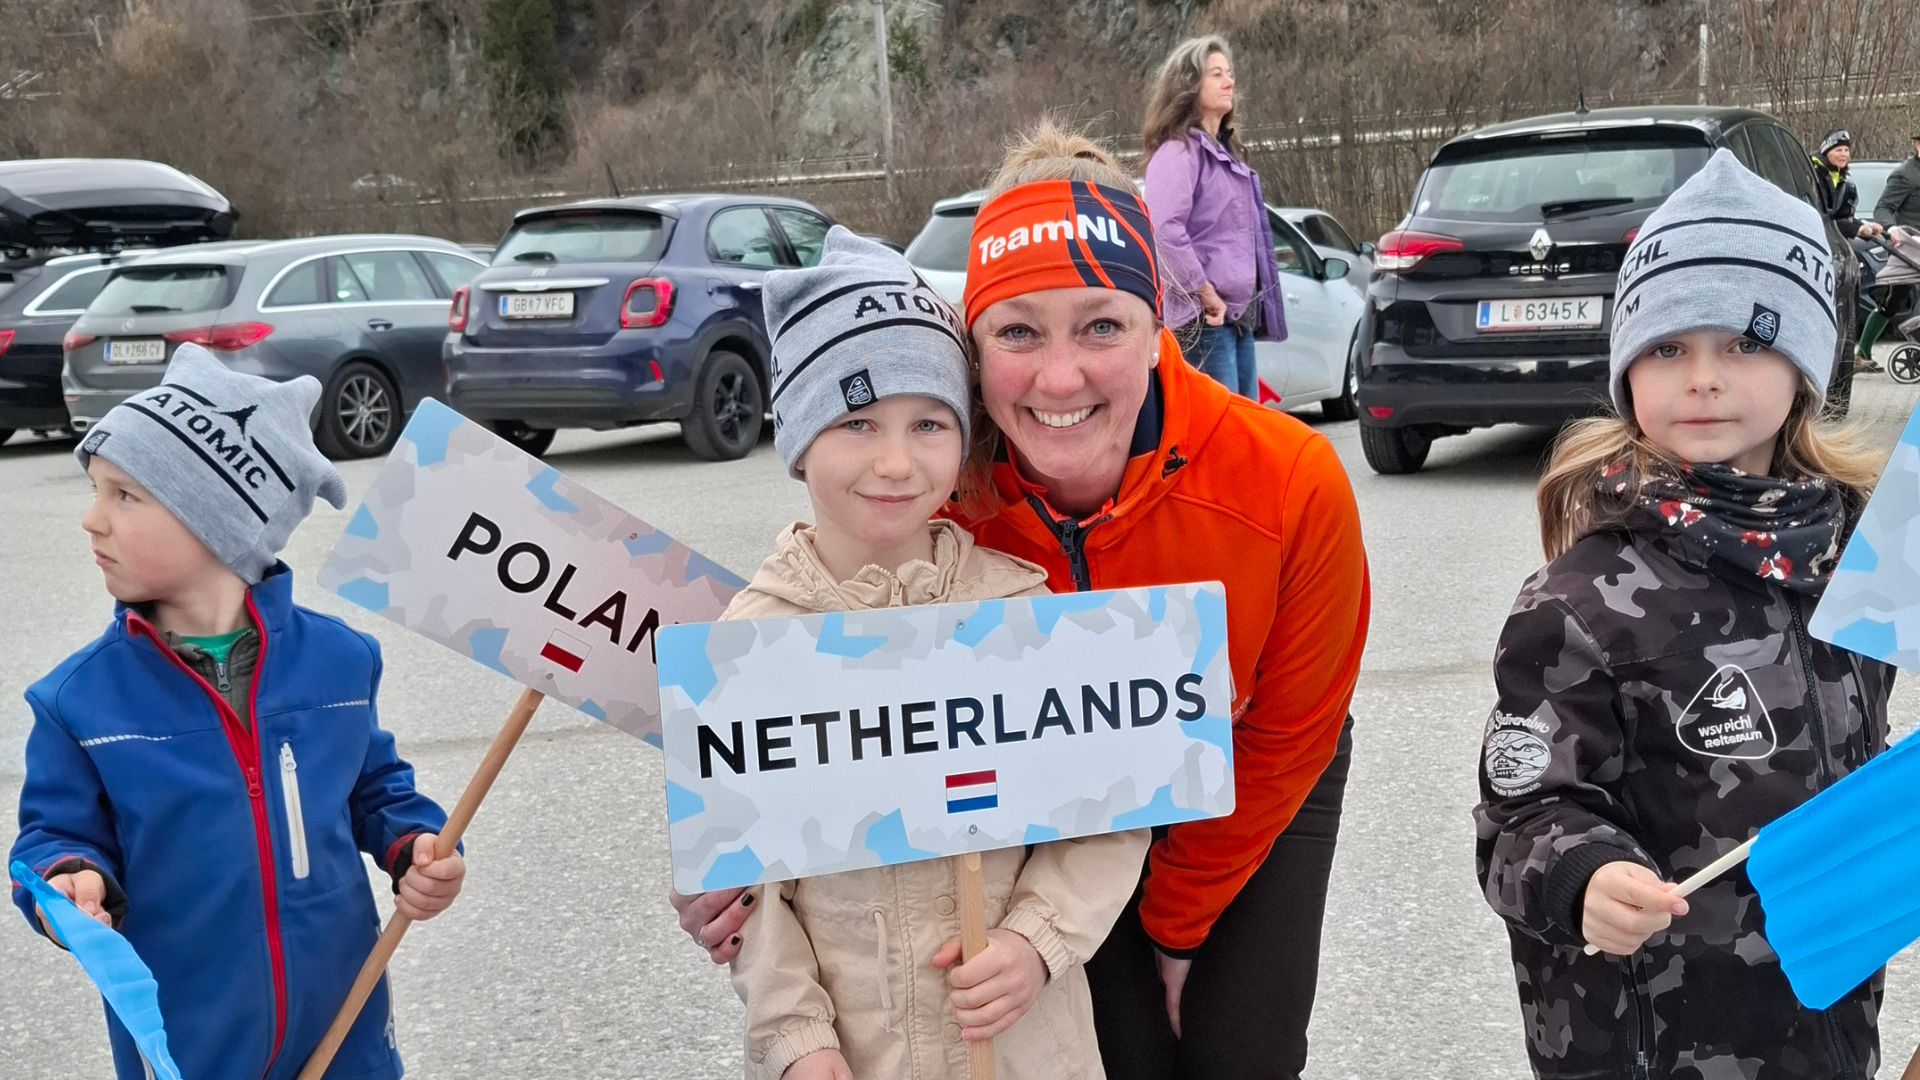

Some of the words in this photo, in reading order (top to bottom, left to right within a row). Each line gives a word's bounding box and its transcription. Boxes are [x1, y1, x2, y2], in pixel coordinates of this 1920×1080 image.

[979, 214, 1126, 265] TeamNL
[1508, 262, 1571, 275] SCENIC
[1785, 245, 1833, 298] ATO
[514, 299, 527, 312] GB
[545, 297, 565, 311] VFC
[1501, 305, 1510, 322] L
[1525, 302, 1573, 320] 6345
[1577, 301, 1589, 320] K
[145, 393, 266, 489] ATOMIC
[447, 511, 658, 665] POLAN
[697, 673, 1207, 779] NETHERLANDS
[1698, 724, 1722, 738] WSV
